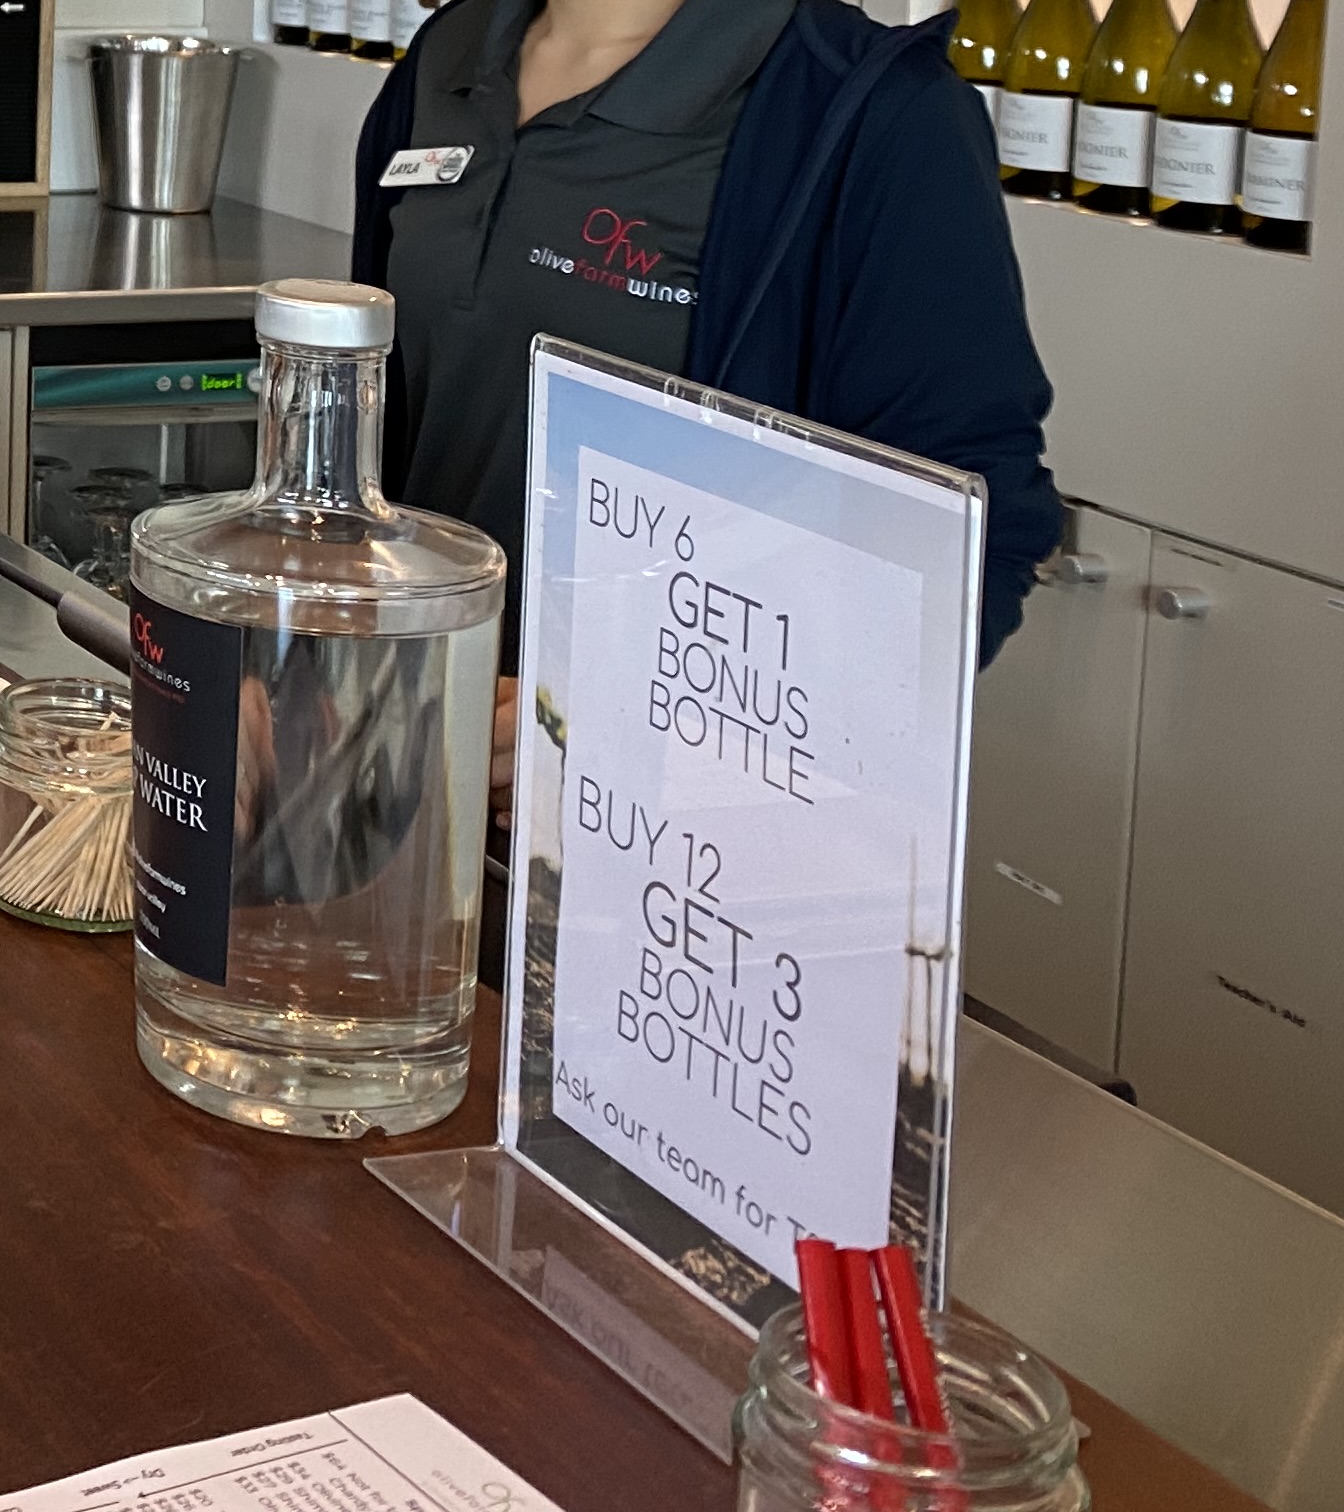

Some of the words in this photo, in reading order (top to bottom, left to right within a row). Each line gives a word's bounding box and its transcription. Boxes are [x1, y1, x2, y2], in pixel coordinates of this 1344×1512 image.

[389, 162, 421, 177] LAYLA
[589, 477, 666, 549] BUY
[674, 515, 694, 562] 6
[668, 571, 763, 653] GET
[776, 613, 789, 671] 1
[649, 679, 815, 805] BOTTLE
[658, 626, 809, 740] BONUS
[139, 773, 209, 832] WATER
[145, 751, 207, 799] VALLEY
[579, 775, 668, 866] BUY
[682, 833, 721, 904] 12
[642, 881, 753, 989] GET
[772, 952, 802, 1022] 3
[617, 989, 812, 1156] BOTTLES
[640, 947, 795, 1084] BONUS
[555, 1060, 596, 1113] Ask
[603, 1102, 648, 1146] our
[656, 1133, 727, 1205] team
[735, 1185, 777, 1236] for
